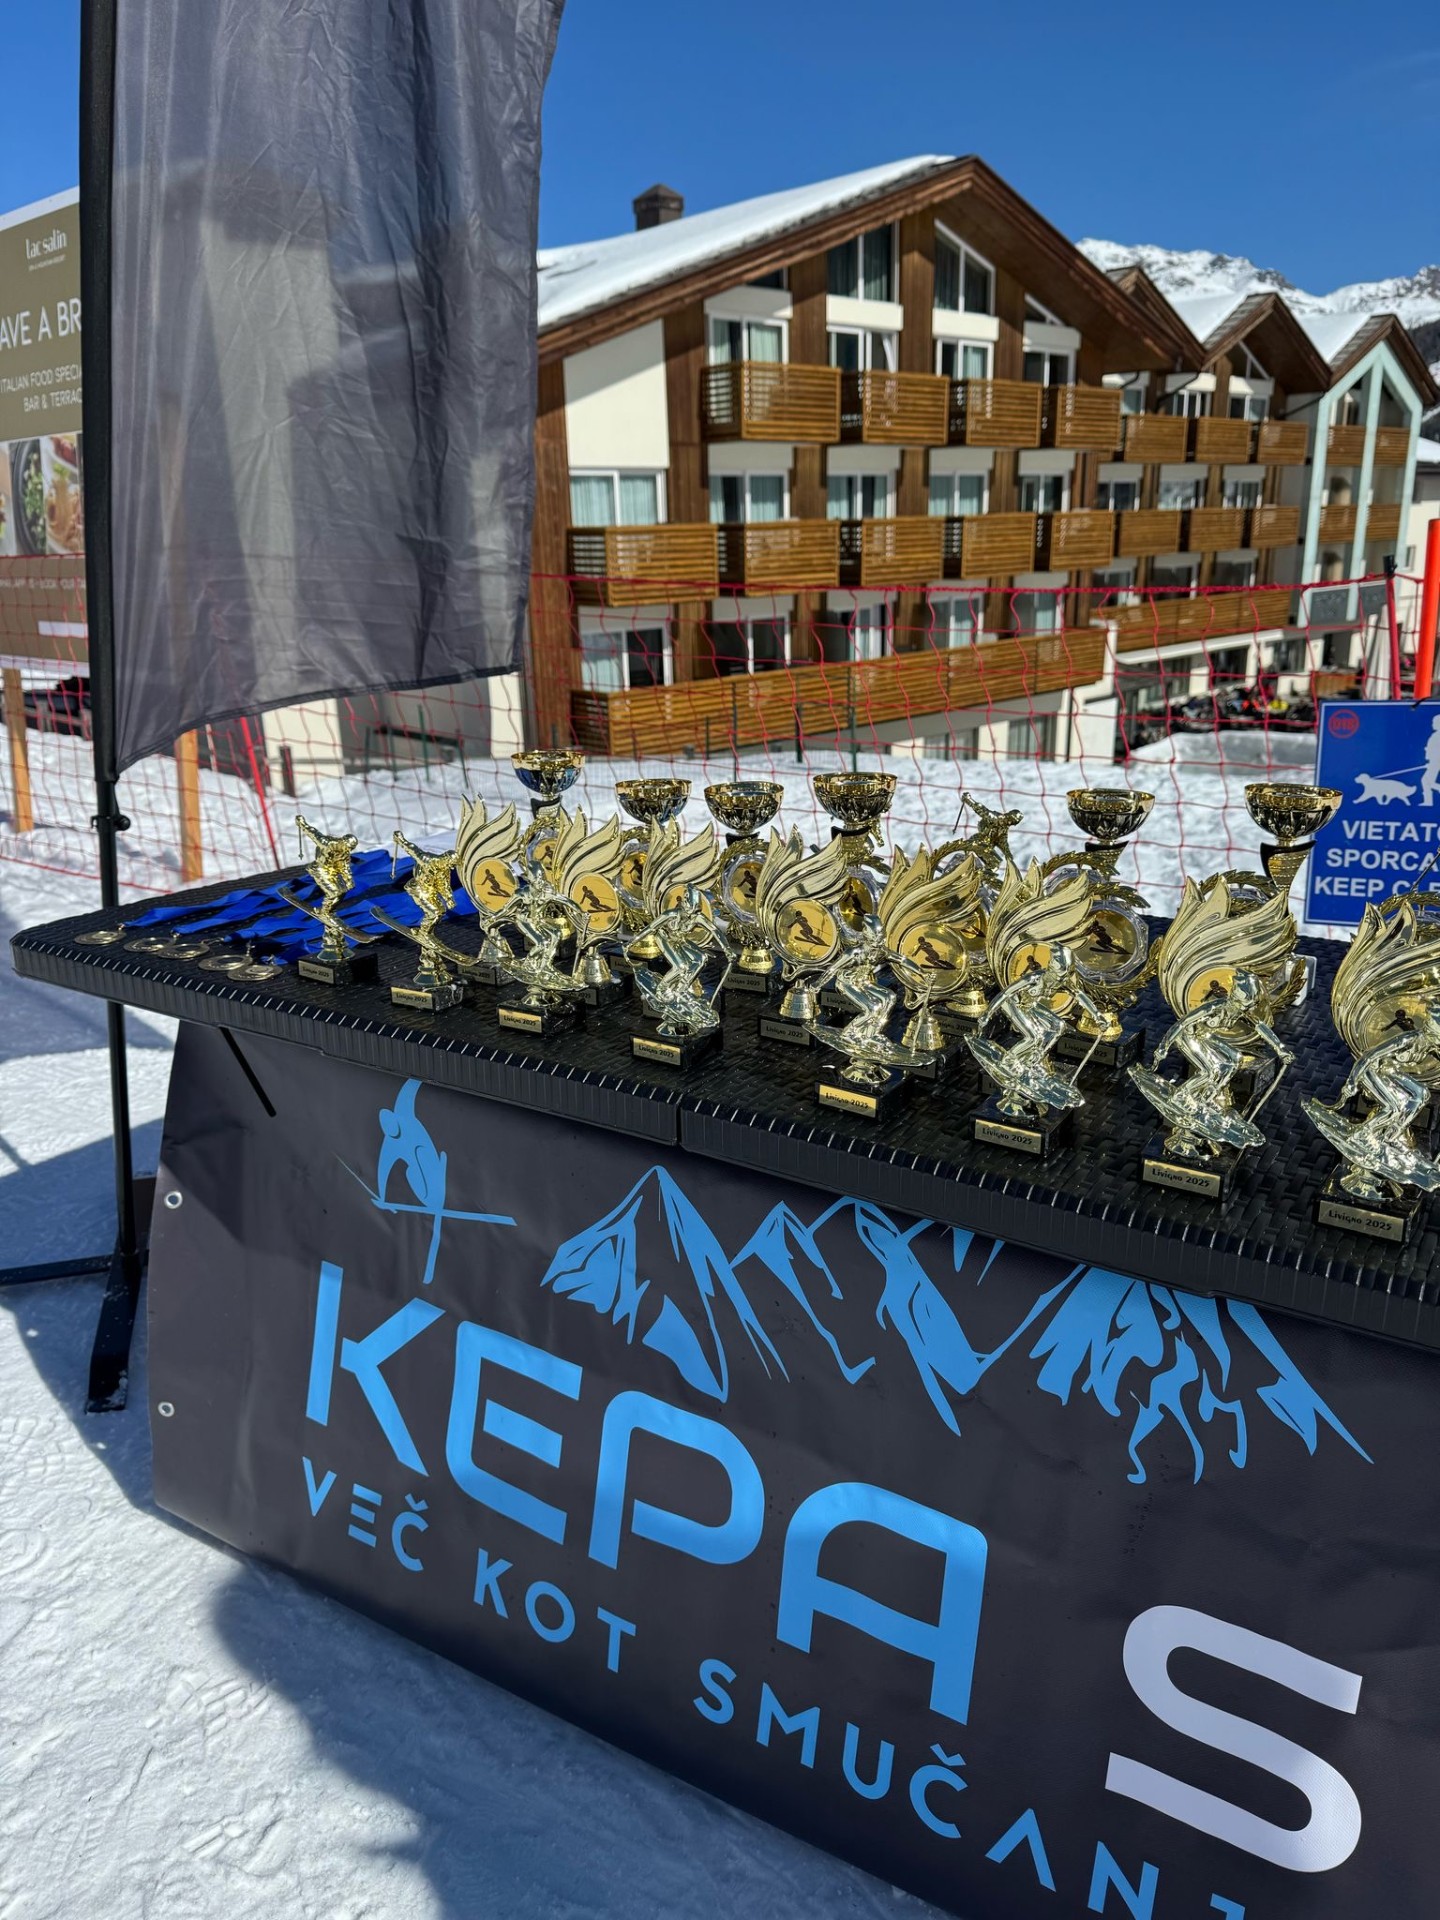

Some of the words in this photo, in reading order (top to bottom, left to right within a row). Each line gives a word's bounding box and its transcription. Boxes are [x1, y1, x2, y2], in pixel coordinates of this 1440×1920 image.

[38, 306, 53, 342] A
[57, 297, 82, 336] BR
[30, 369, 54, 387] FOOD
[1342, 820, 1440, 842] VIETAT
[1314, 876, 1385, 898] KEEP
[1011, 1134, 1033, 1145] 2025
[1152, 1168, 1182, 1181] Livigno
[1185, 1175, 1211, 1187] 2025
[1328, 1210, 1362, 1224] Livigno
[1365, 1218, 1393, 1231] 2025
[306, 1260, 988, 1726] KEPA
[302, 1456, 429, 1572] VEČ
[473, 1548, 636, 1674] KOT
